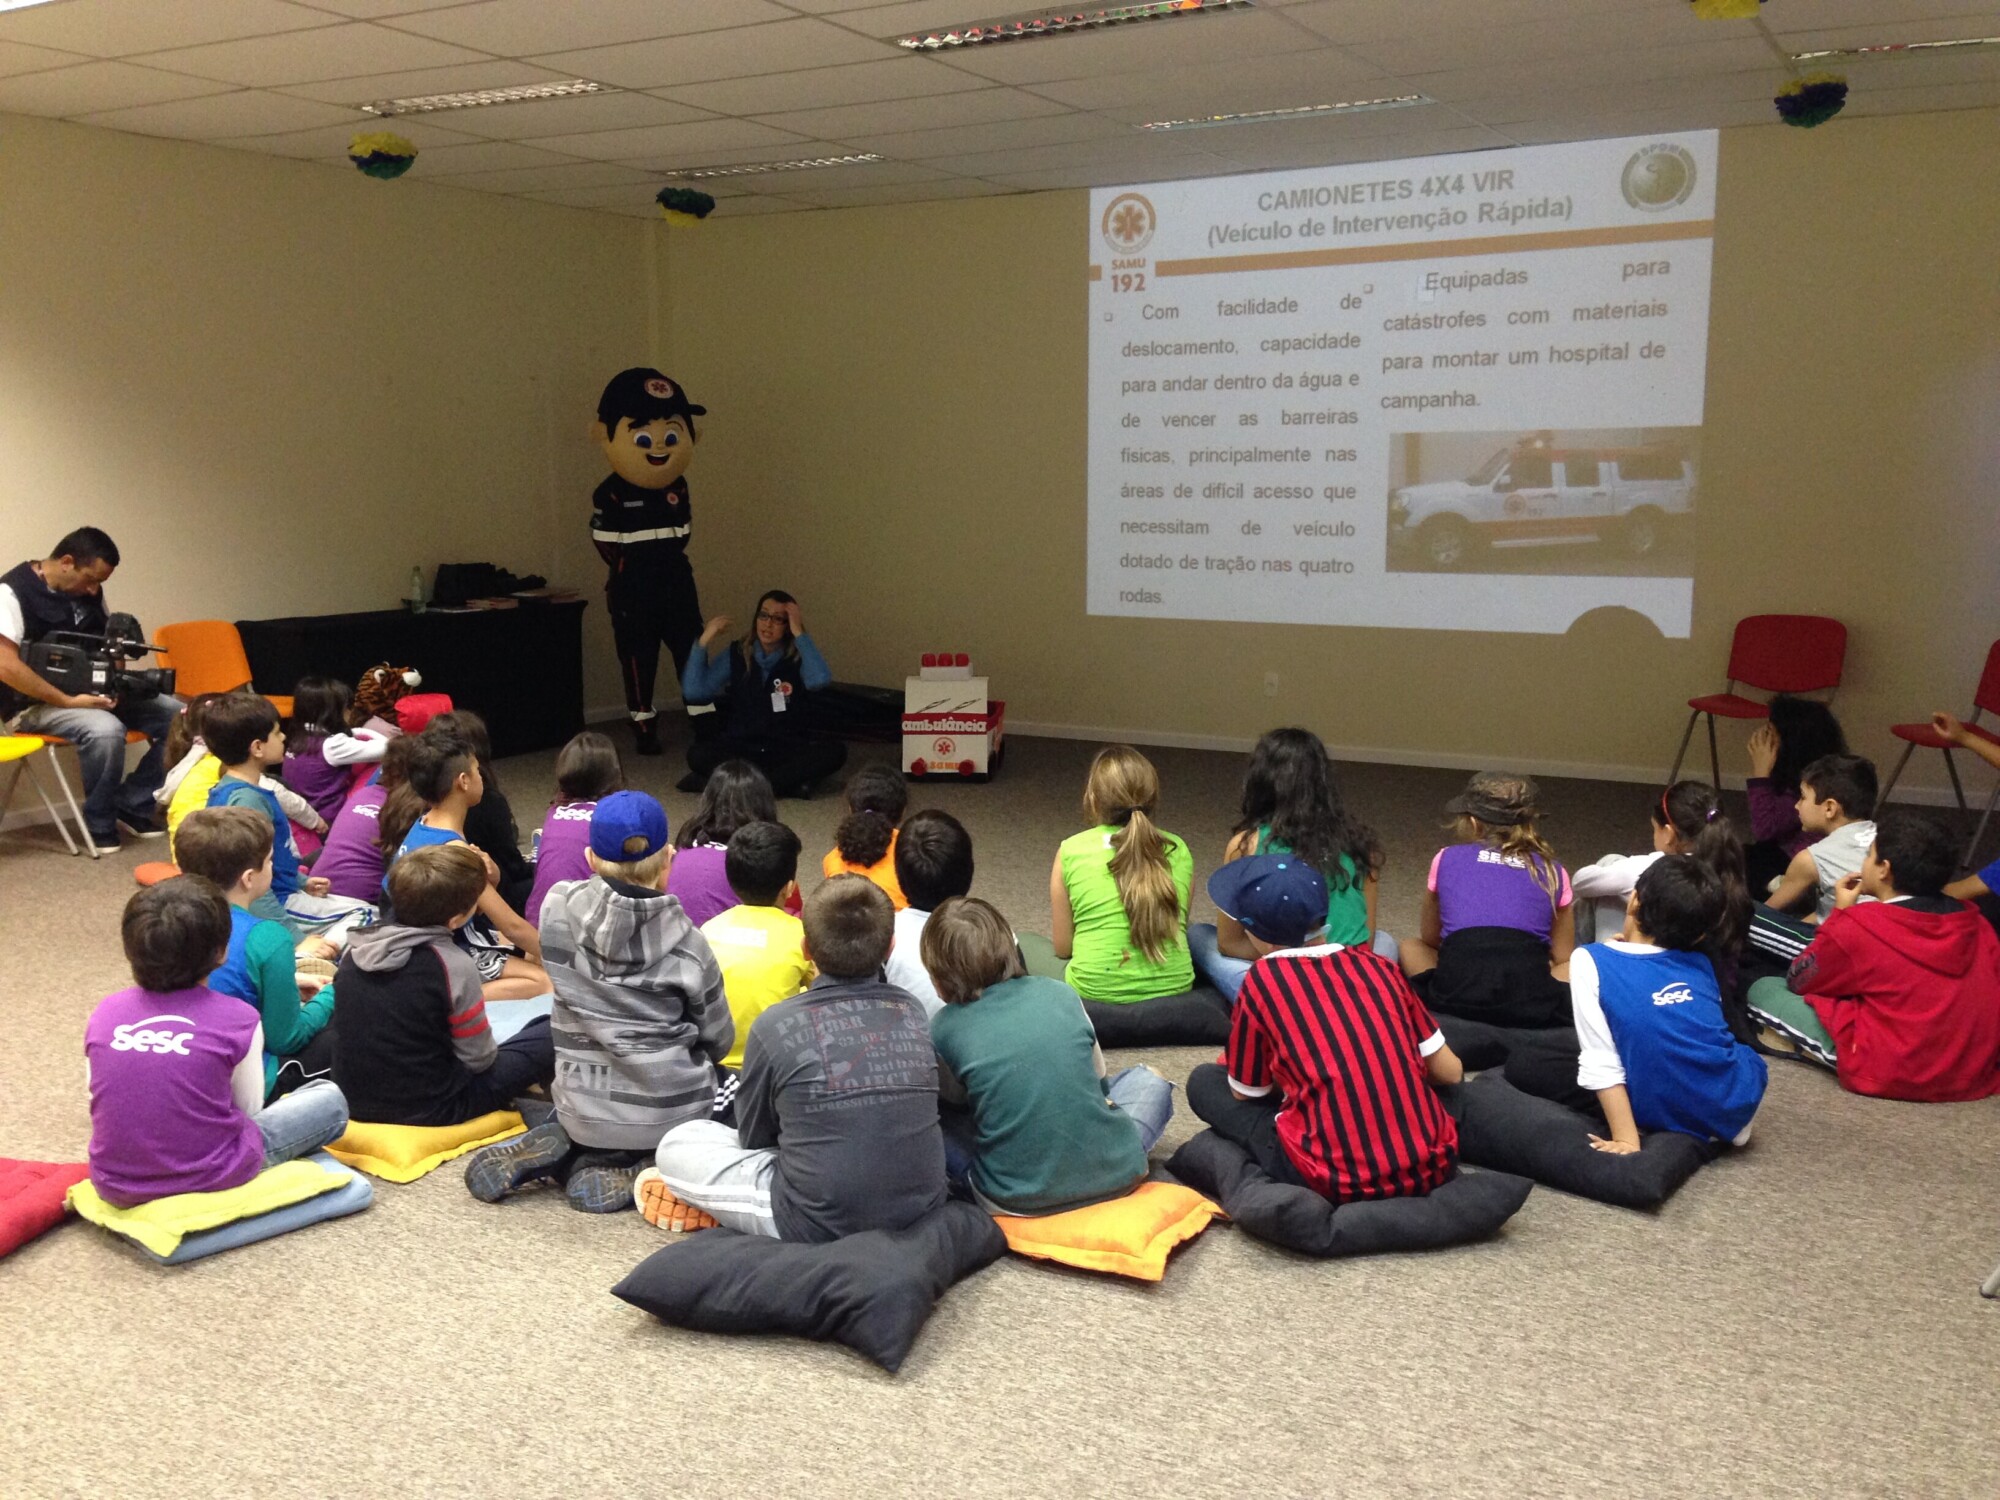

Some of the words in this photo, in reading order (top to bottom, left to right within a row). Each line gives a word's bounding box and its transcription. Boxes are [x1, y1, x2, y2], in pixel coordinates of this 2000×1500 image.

[1257, 180, 1413, 212] CAMIONETES
[1420, 174, 1465, 196] 4X4
[1473, 170, 1514, 192] VIR
[1208, 220, 1292, 248] (Veículo
[1299, 219, 1325, 237] de
[1333, 207, 1467, 235] Intervenção
[1478, 196, 1573, 225] Rápida)
[1111, 258, 1146, 270] SAMU
[1425, 268, 1528, 292] Equipadas
[1622, 259, 1670, 281] para
[1111, 274, 1146, 293] 192
[1142, 304, 1179, 320] Com
[1217, 297, 1298, 317] facilidade
[1340, 294, 1362, 311] de
[1383, 310, 1486, 331] catástrofes
[1507, 307, 1549, 325] com
[1572, 300, 1668, 321] materiais
[1121, 339, 1239, 357] deslocamento,
[1260, 333, 1361, 354] capacidade
[1382, 353, 1423, 374] para
[1432, 350, 1500, 369] montar
[1508, 349, 1538, 365] um
[1549, 343, 1629, 365] hospital
[1640, 341, 1666, 359] de
[1121, 380, 1156, 396] para
[1162, 376, 1208, 392] andar
[1214, 374, 1267, 391] dentro
[1272, 373, 1293, 389] da
[1299, 371, 1342, 391] água
[1349, 373, 1360, 386] e
[1381, 391, 1480, 411] campanha.
[1121, 412, 1141, 428] de
[1162, 414, 1216, 427] vencer
[1239, 413, 1258, 426] as
[1281, 409, 1358, 426] barreiras
[1189, 446, 1311, 466] principalmente
[1324, 447, 1357, 461] nas
[1120, 483, 1164, 499] áreas
[1173, 483, 1193, 498] de
[1253, 485, 1313, 500] acesso
[1323, 485, 1356, 503] que
[1120, 519, 1209, 535] necessitam
[1241, 519, 1261, 536] de
[1293, 520, 1356, 537] veículo
[1120, 553, 1173, 569] dotado
[1179, 554, 1199, 570] de
[1205, 555, 1256, 574] tração
[1262, 559, 1293, 572] nas
[1299, 559, 1354, 576] quatro
[902, 716, 987, 731] ambulância
[109, 1015, 196, 1055] Sesc
